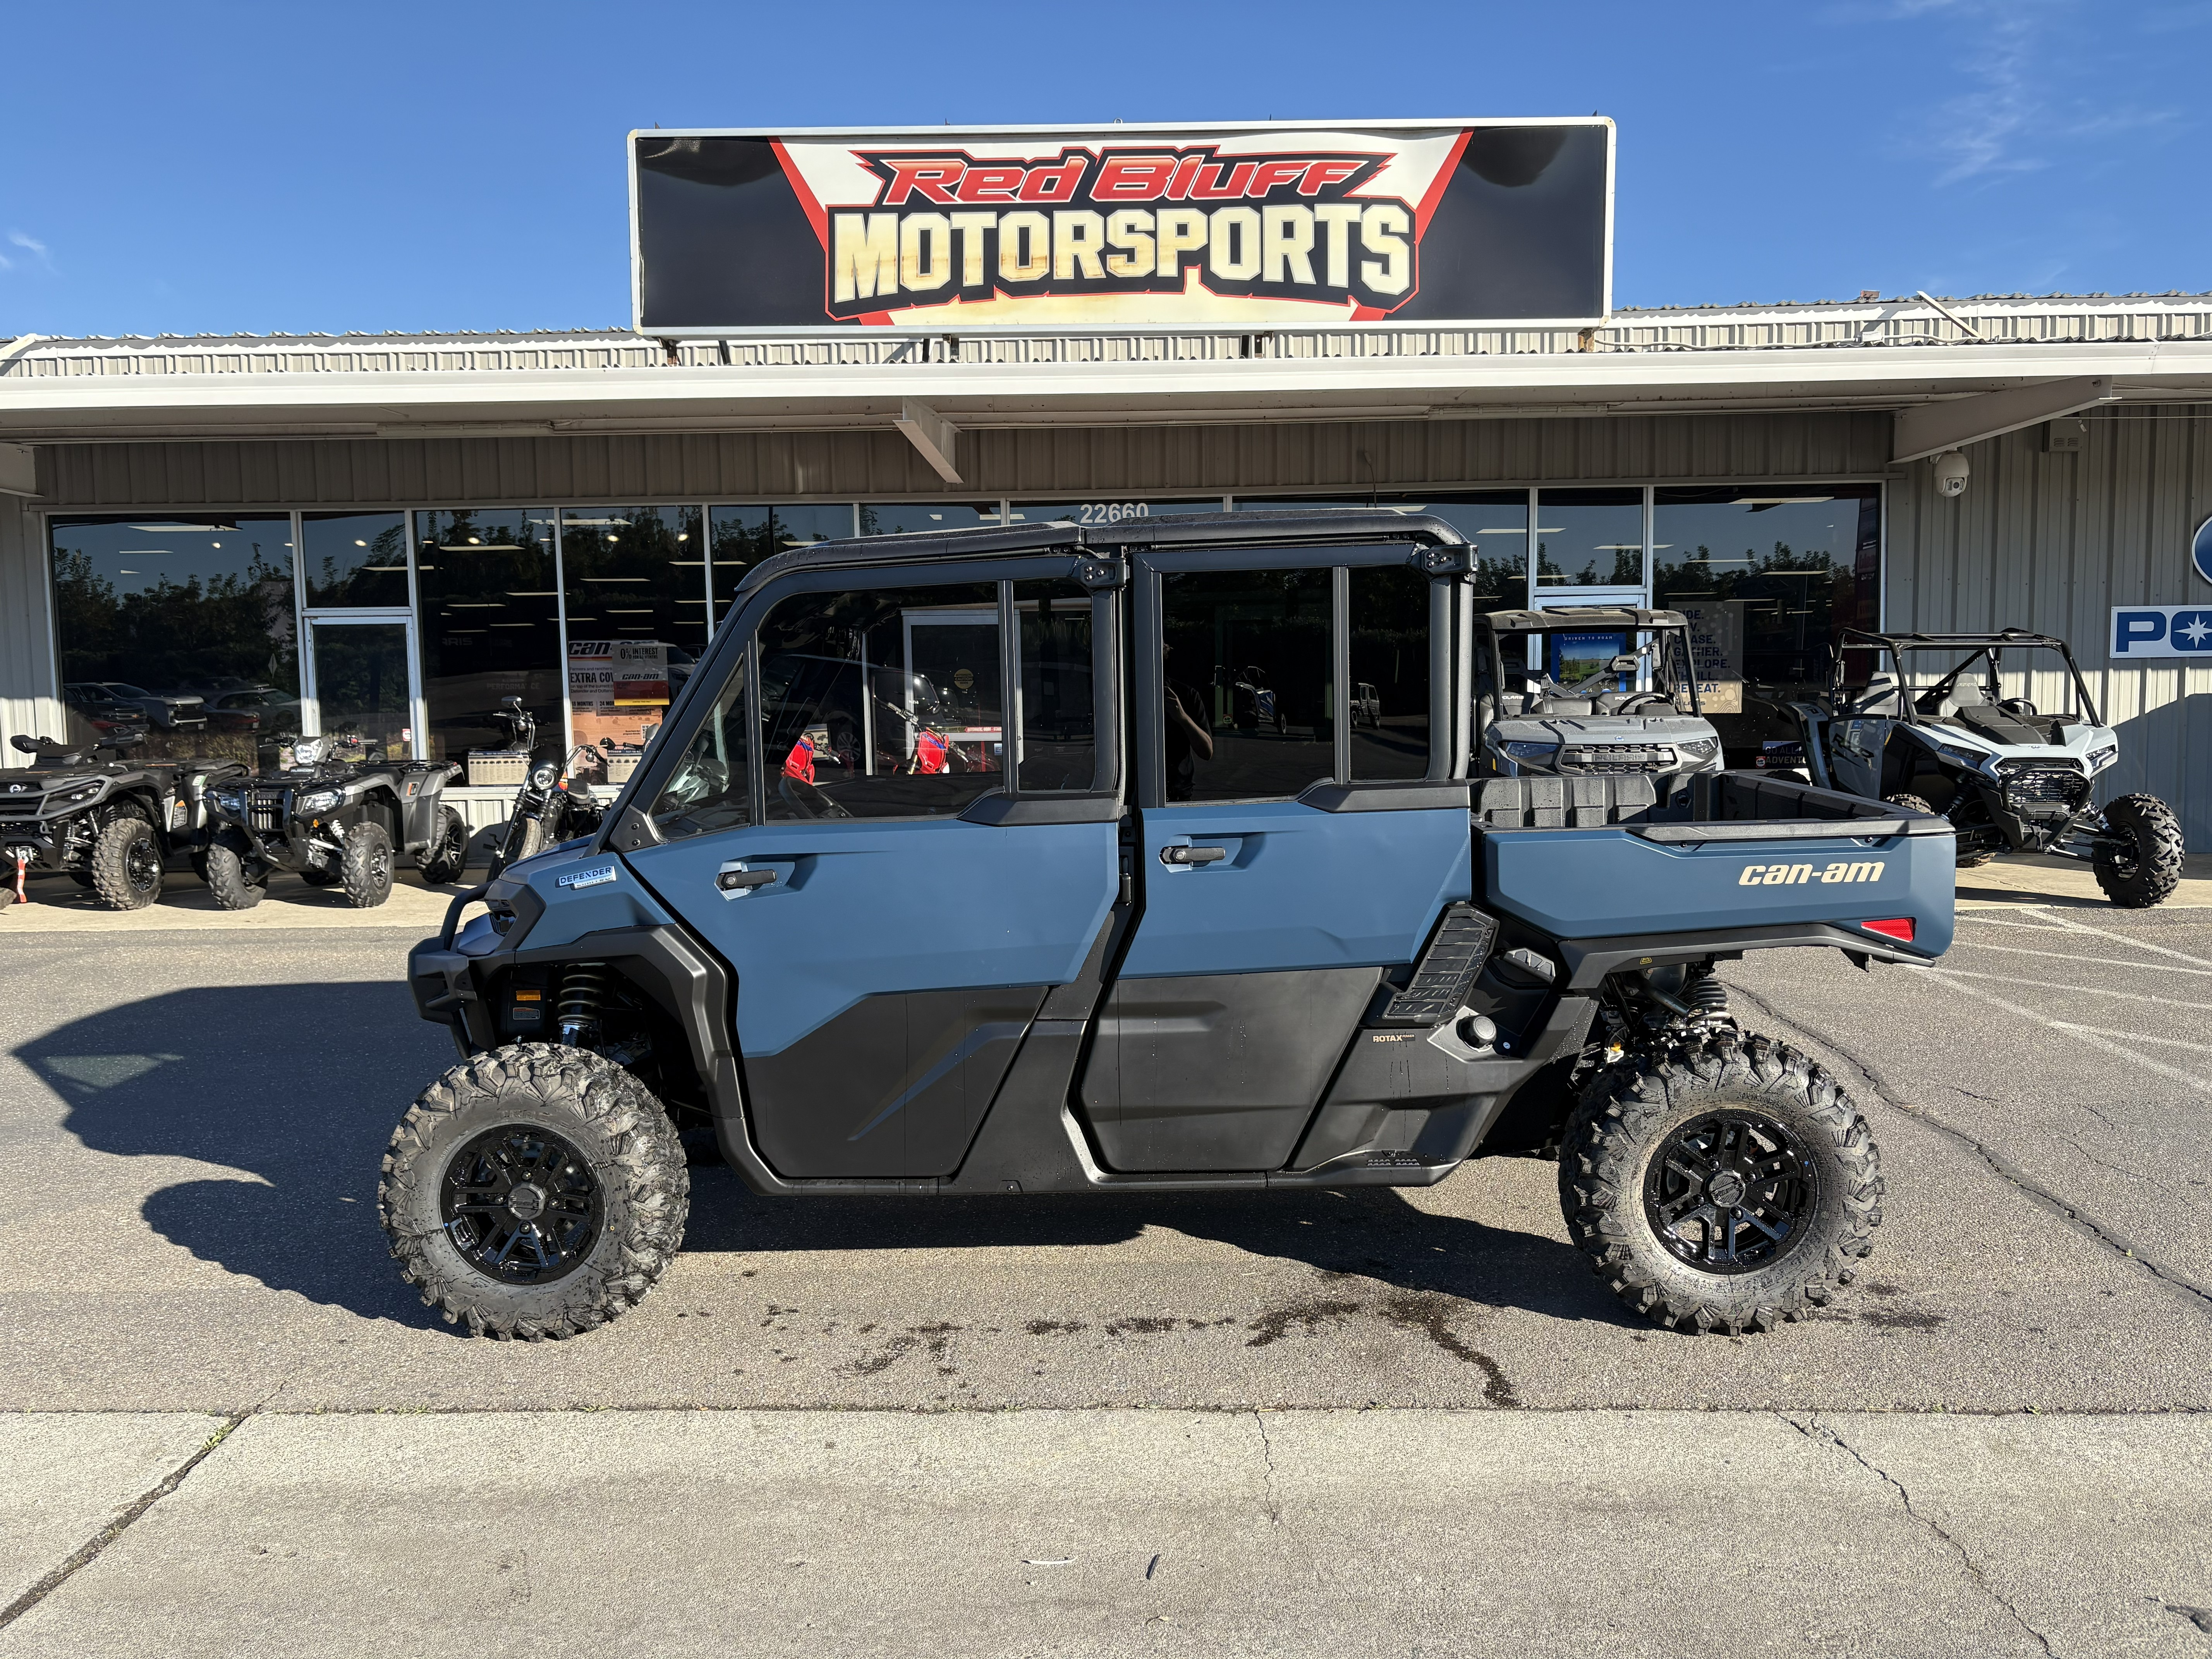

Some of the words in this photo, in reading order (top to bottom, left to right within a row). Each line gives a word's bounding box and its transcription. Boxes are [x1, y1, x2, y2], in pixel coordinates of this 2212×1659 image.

[880, 156, 1089, 205] Red
[1089, 155, 1369, 201] Bluff
[835, 204, 1409, 303] MOTORSPORTS
[1080, 503, 1149, 523] 22660
[1677, 610, 1704, 619] IDE.
[1674, 635, 1716, 644] CASE.
[620, 648, 632, 659] 0%
[1674, 647, 1723, 656] GTHER.
[1676, 659, 1731, 669] ELORE.
[570, 673, 596, 683] EXTRA
[1674, 683, 1720, 693] REEAT.
[1765, 746, 1777, 754] GO
[560, 867, 611, 884] DEFENDER
[1738, 862, 1885, 885] can-am
